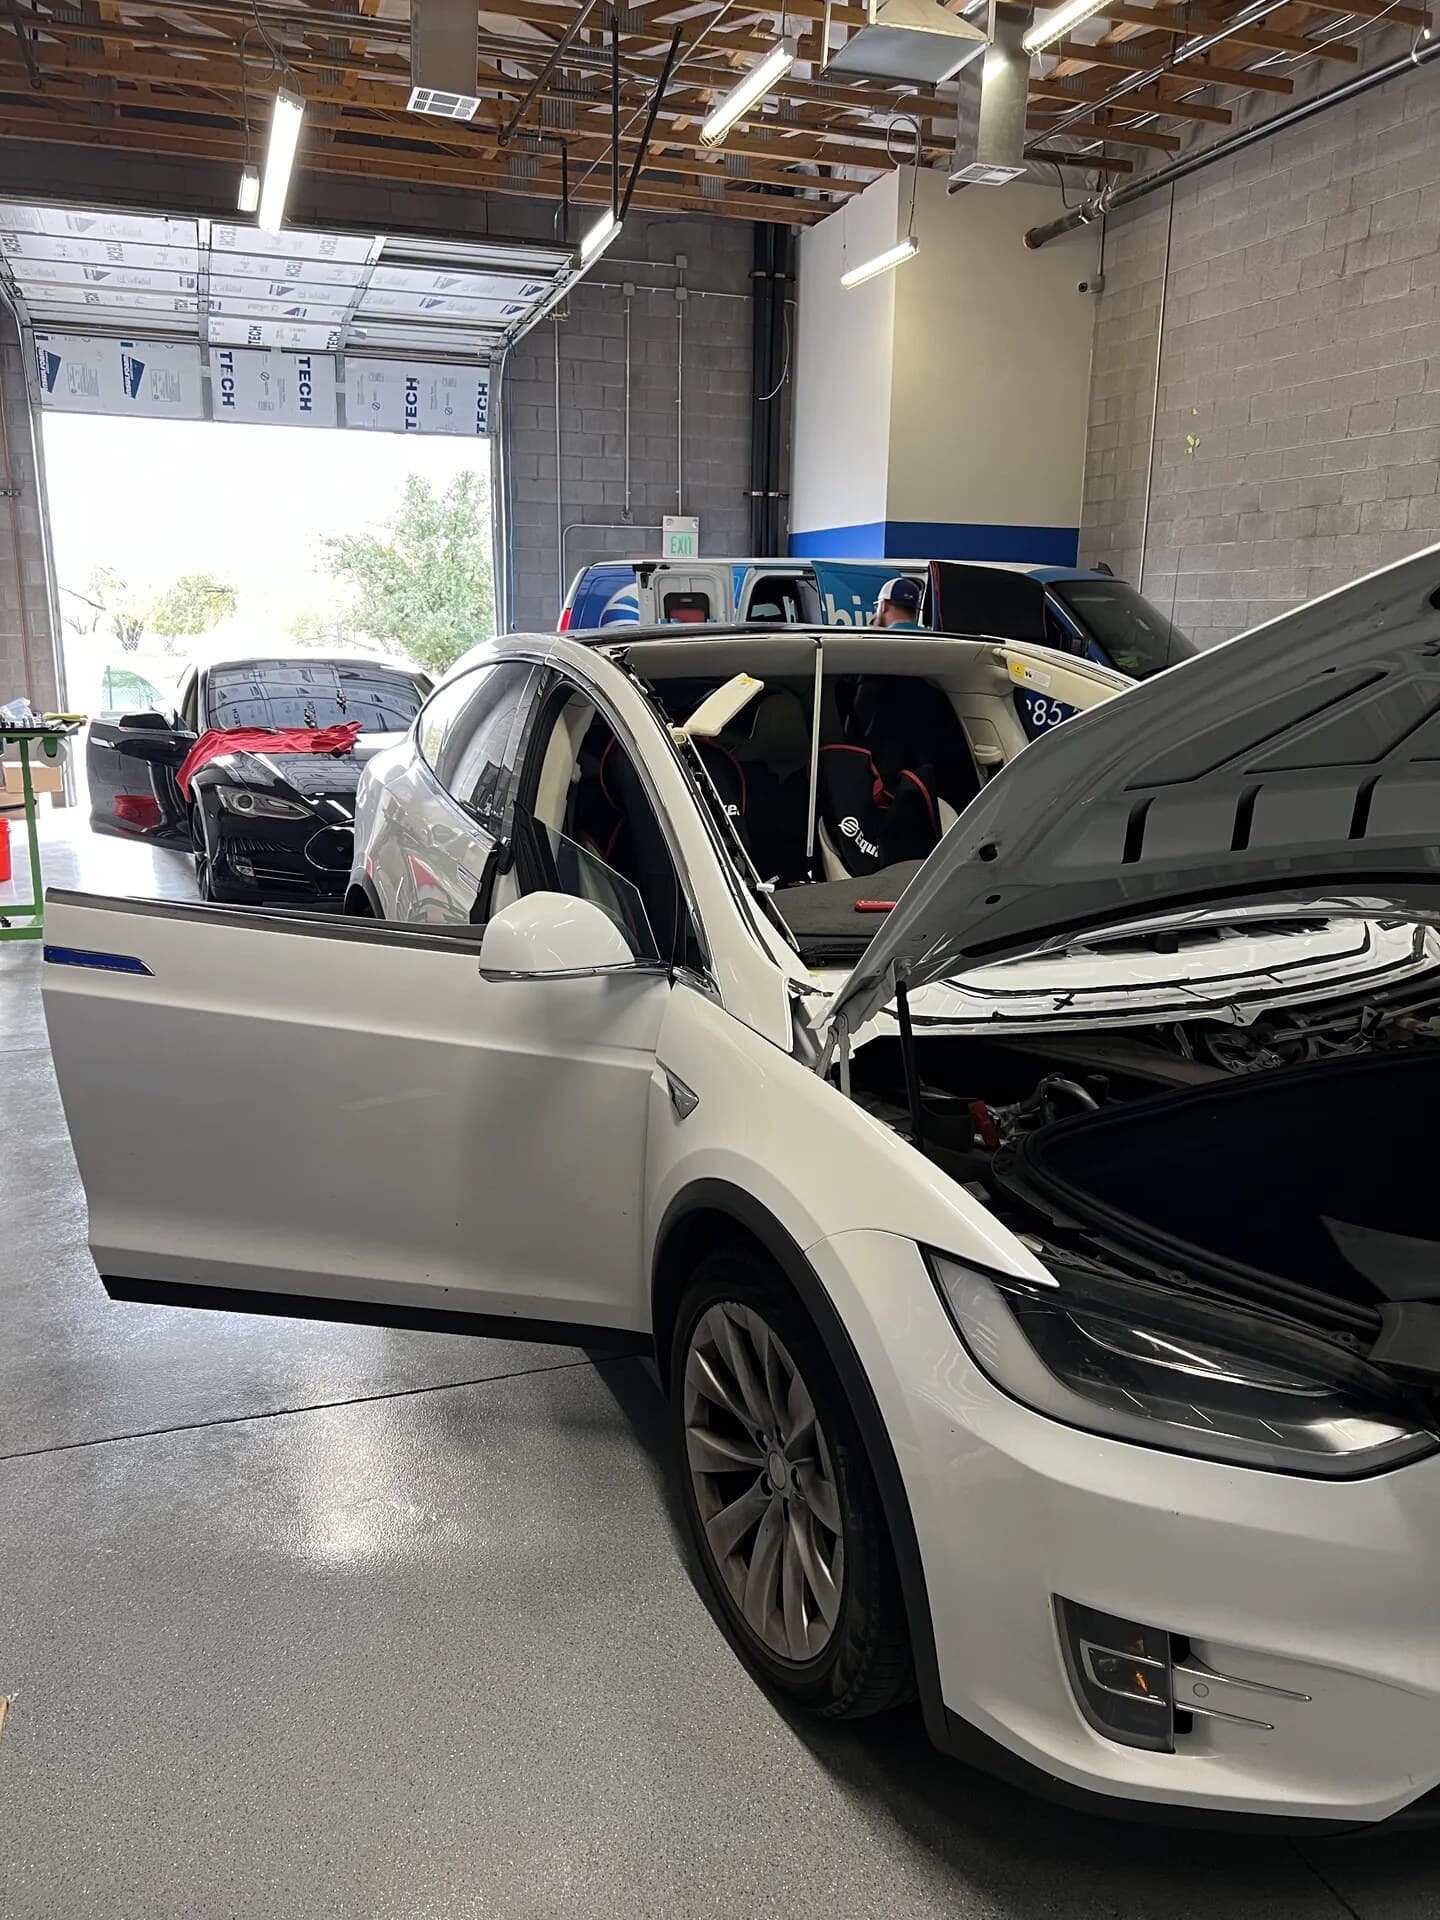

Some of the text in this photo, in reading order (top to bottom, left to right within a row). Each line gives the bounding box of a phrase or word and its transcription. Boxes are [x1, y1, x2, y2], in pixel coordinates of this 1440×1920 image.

[248, 325, 262, 345] TECH
[326, 331, 340, 350] TECH
[298, 356, 312, 411] TECH
[405, 376, 418, 430] TECH
[670, 536, 692, 554] EXIT
